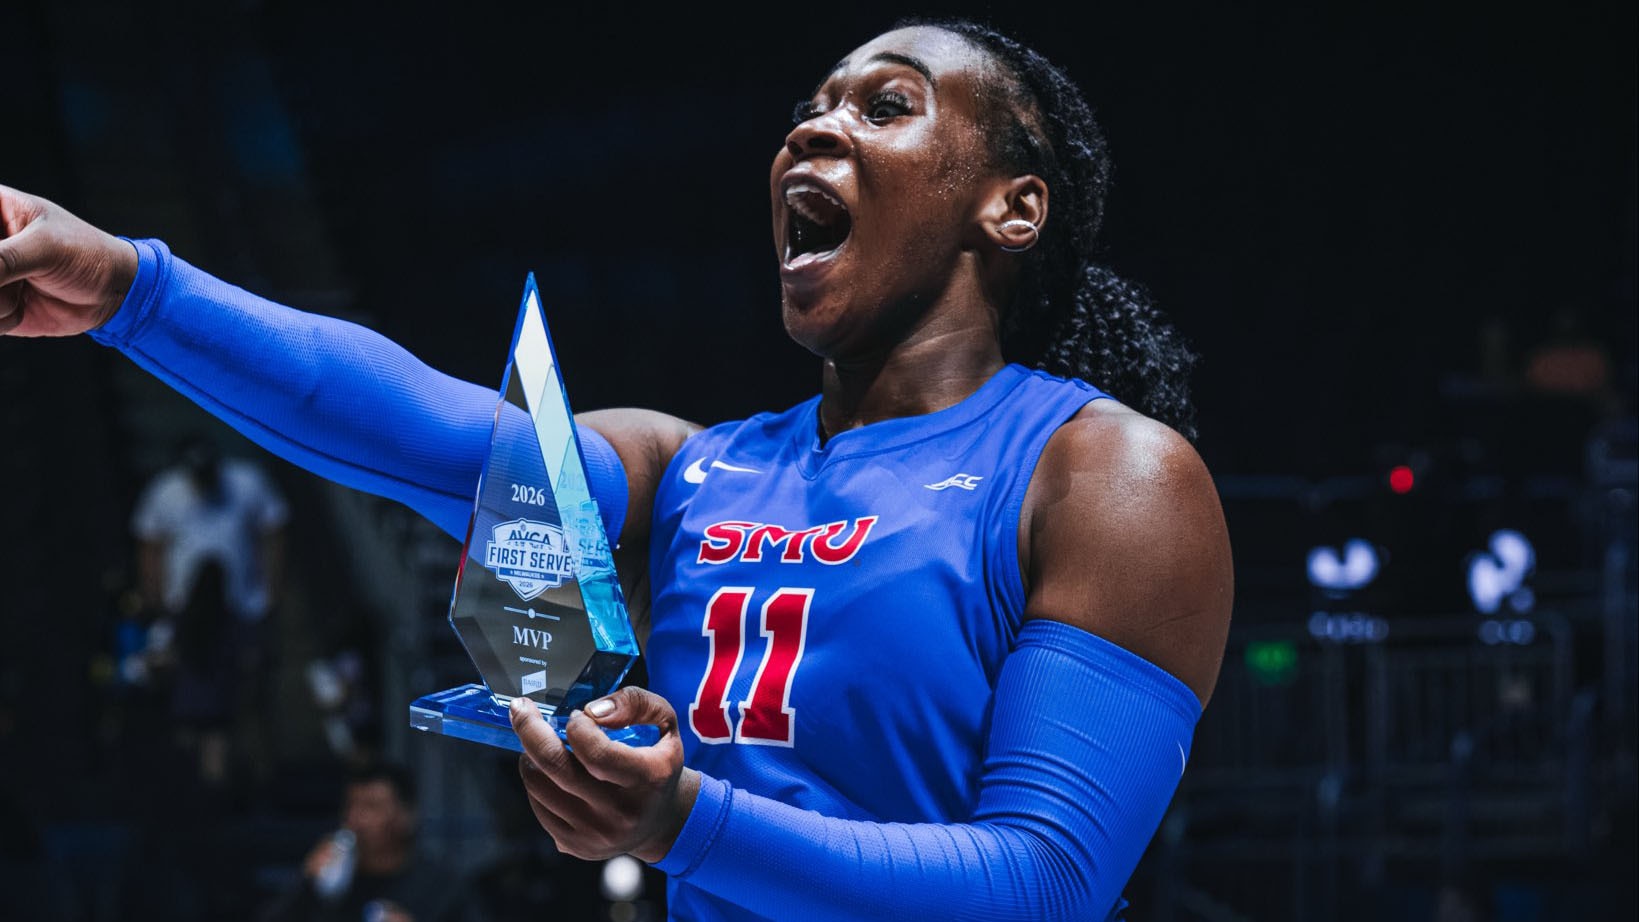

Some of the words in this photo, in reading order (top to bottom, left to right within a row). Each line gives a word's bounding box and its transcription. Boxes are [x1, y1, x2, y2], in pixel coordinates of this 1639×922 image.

[511, 483, 545, 507] 2026
[696, 515, 880, 566] SMU
[489, 546, 525, 567] FIRST
[530, 552, 573, 574] SERVE
[512, 625, 553, 651] MVP
[542, 659, 548, 667] by
[688, 586, 816, 748] 11
